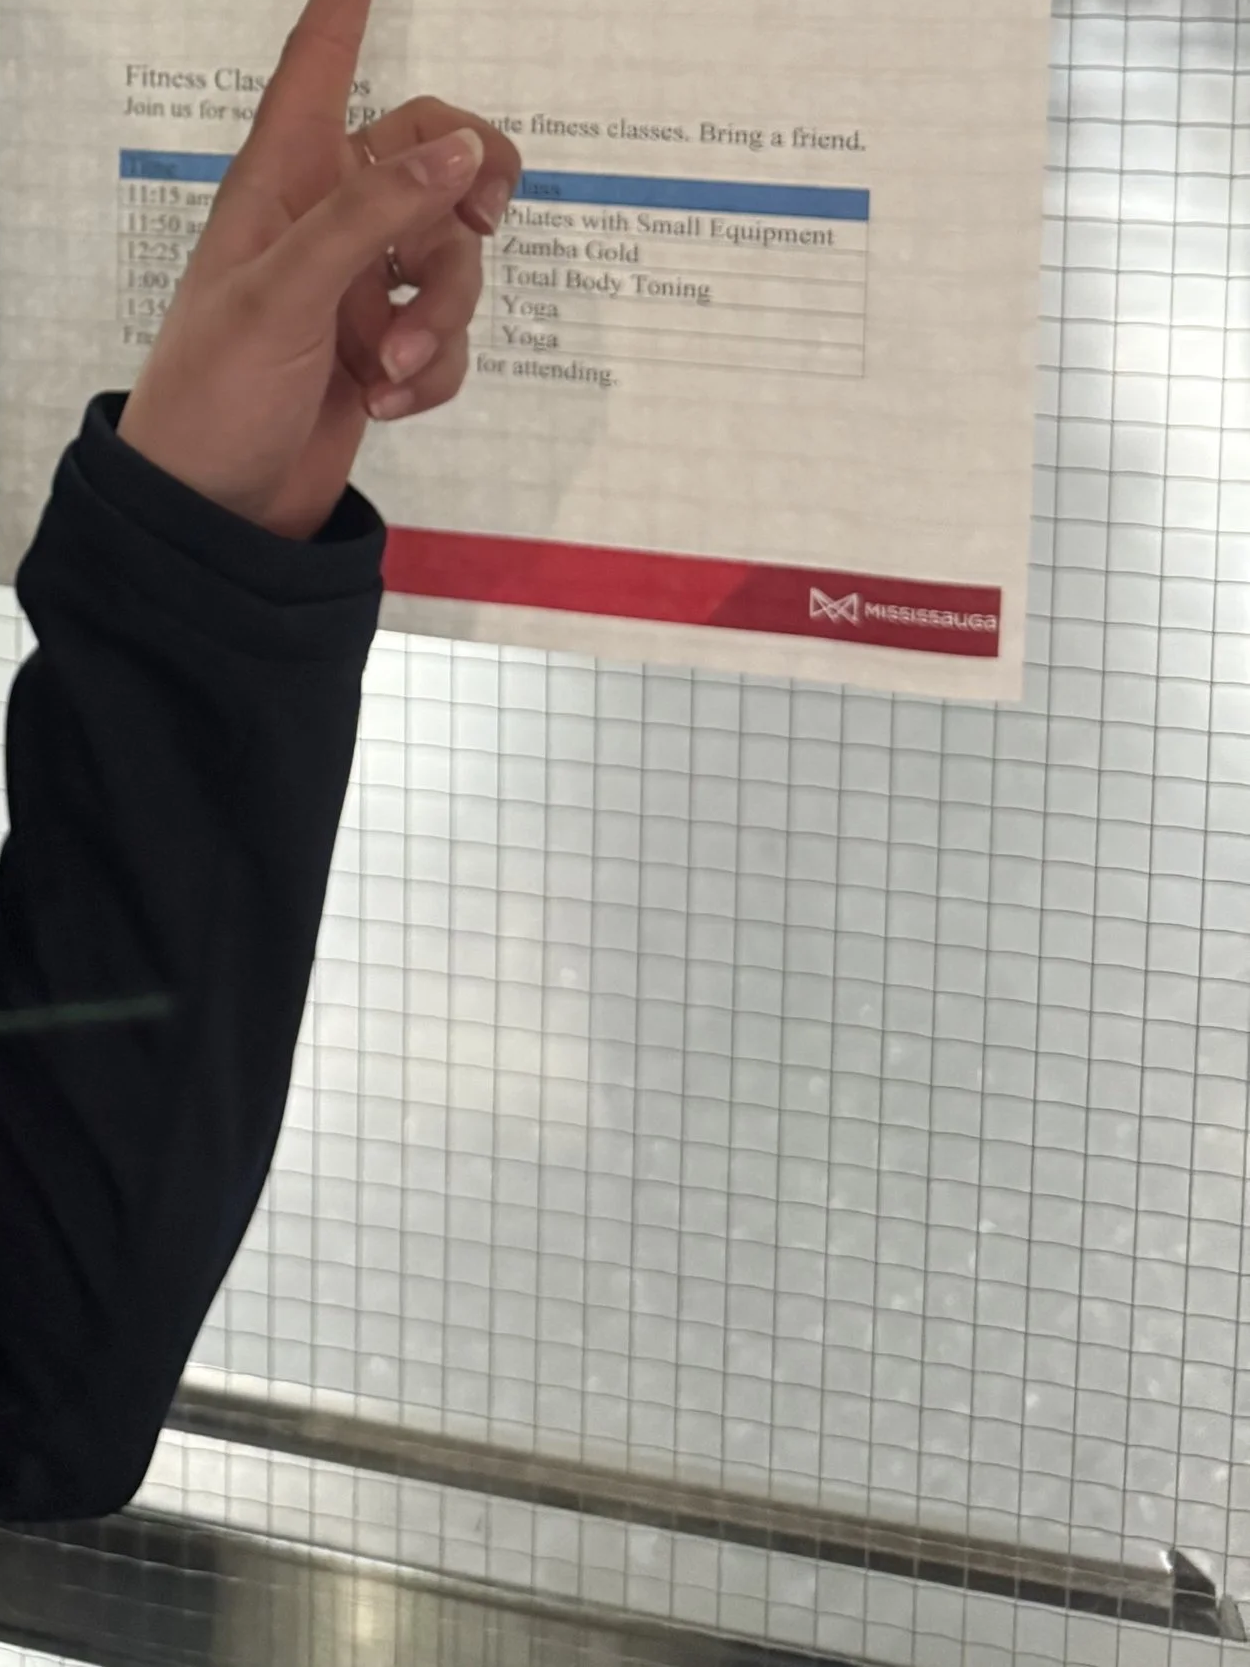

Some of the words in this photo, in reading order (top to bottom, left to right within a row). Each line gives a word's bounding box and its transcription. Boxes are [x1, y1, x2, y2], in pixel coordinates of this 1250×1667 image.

[124, 64, 208, 91] Fitness
[123, 97, 166, 117] Join
[170, 101, 193, 119] us
[200, 99, 227, 120] for
[530, 113, 600, 137] fitness
[606, 117, 689, 143] classes.
[700, 121, 765, 152] Bring
[770, 132, 784, 148] a
[791, 126, 867, 152] friend.
[128, 183, 180, 205] 11:15
[520, 174, 564, 197] lass
[128, 213, 181, 234] 11:50
[504, 205, 575, 228] Pilates
[581, 211, 629, 233] with
[637, 213, 701, 235] Small
[710, 217, 835, 247] Equipment
[128, 240, 181, 262] 12:25
[501, 236, 579, 259] Zumba
[585, 239, 640, 264] Gold
[128, 269, 171, 290] 1:00
[502, 264, 558, 288] Total
[565, 269, 622, 298] Body
[630, 272, 713, 304] Toning
[501, 294, 559, 322] Yoga
[501, 324, 559, 351] Yoga
[476, 352, 506, 374] for
[512, 359, 620, 387] attending.
